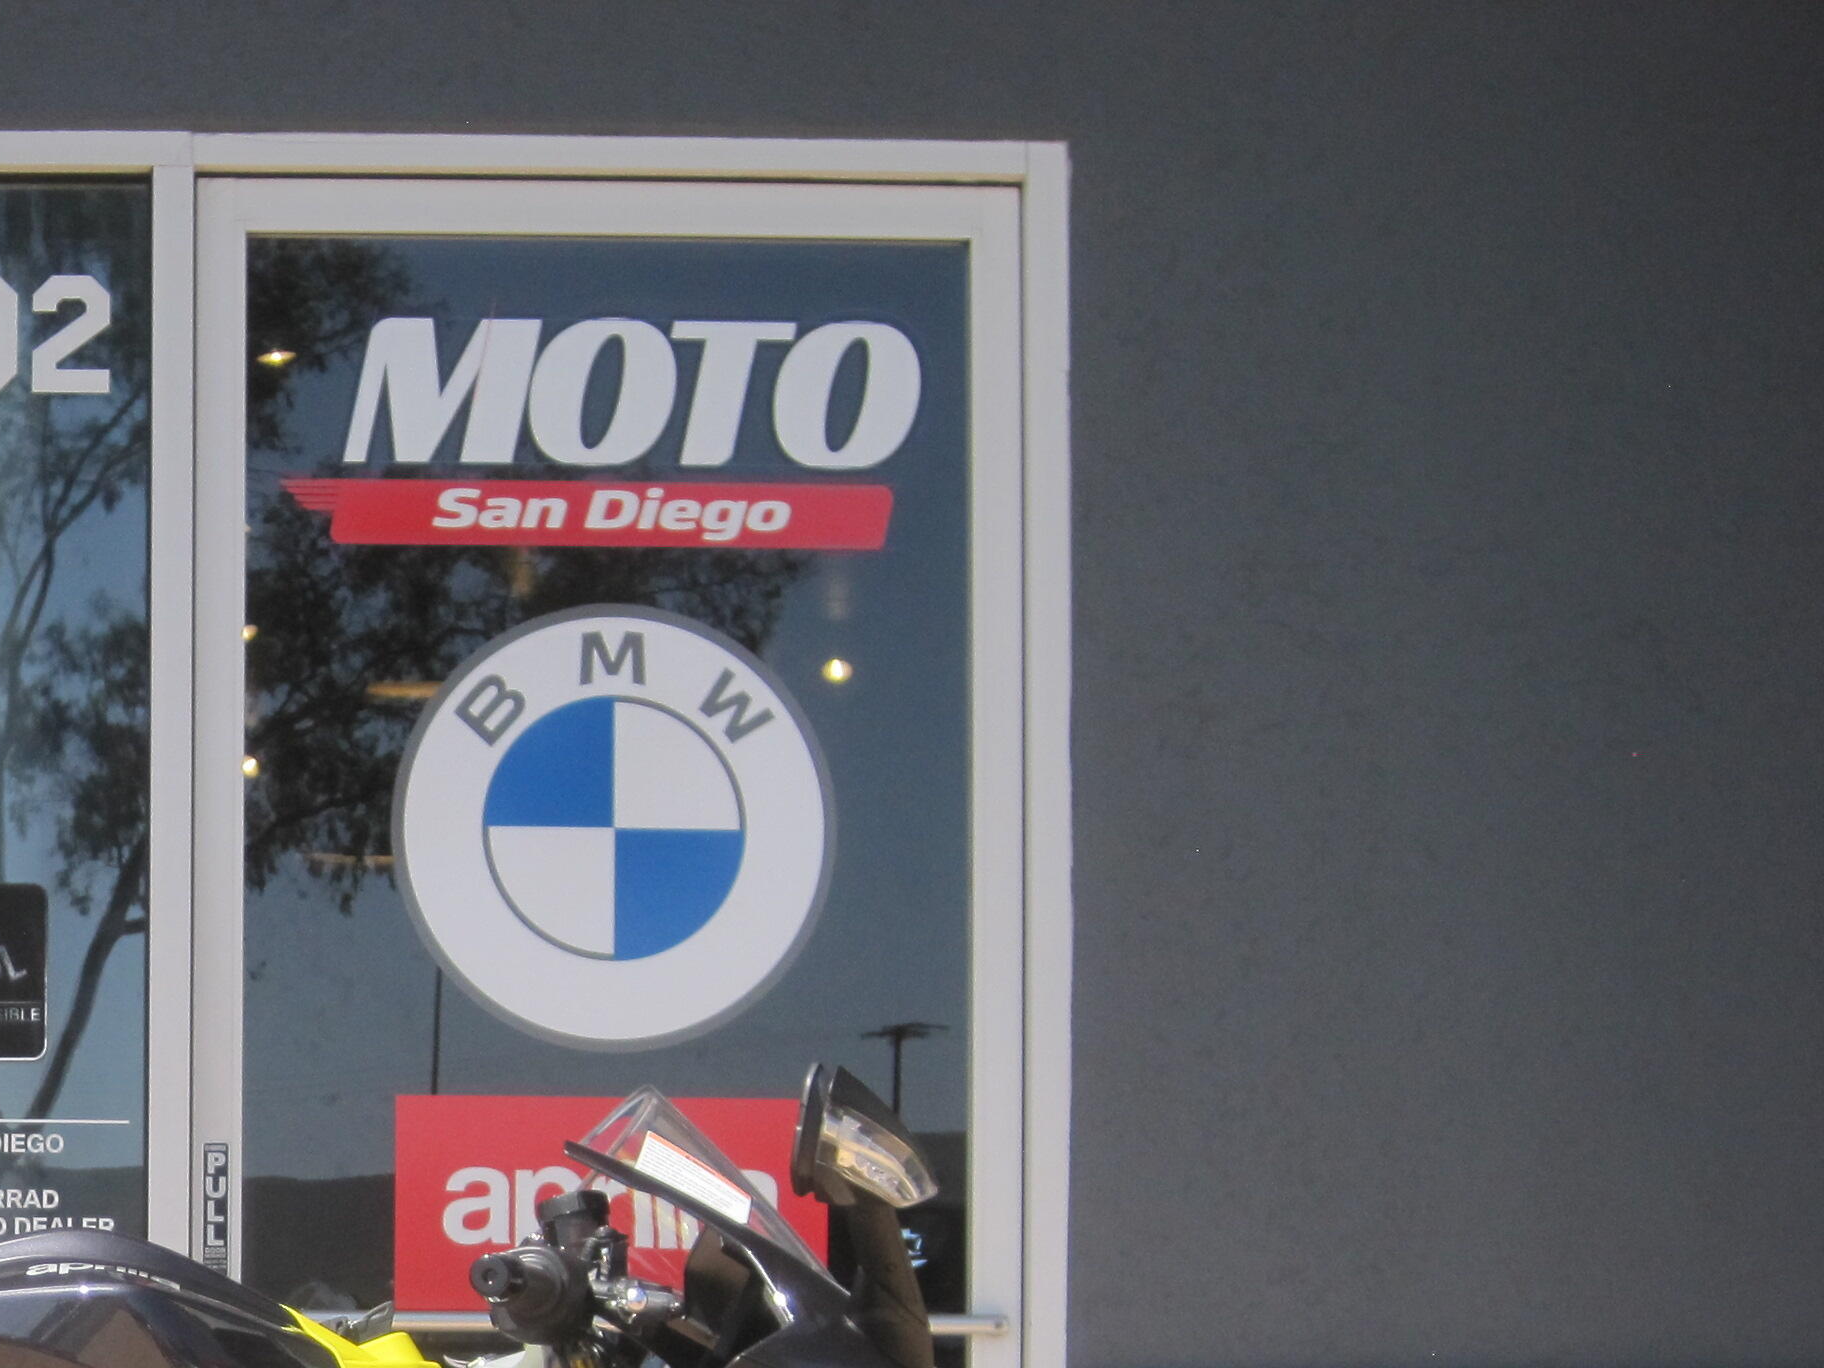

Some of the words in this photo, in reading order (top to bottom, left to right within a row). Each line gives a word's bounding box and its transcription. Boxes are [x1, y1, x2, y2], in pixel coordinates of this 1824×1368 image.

[342, 317, 922, 469] MOTO
[432, 487, 565, 530] San
[584, 488, 791, 541] Diego
[454, 631, 776, 747] BMW
[205, 1152, 226, 1246] PULL
